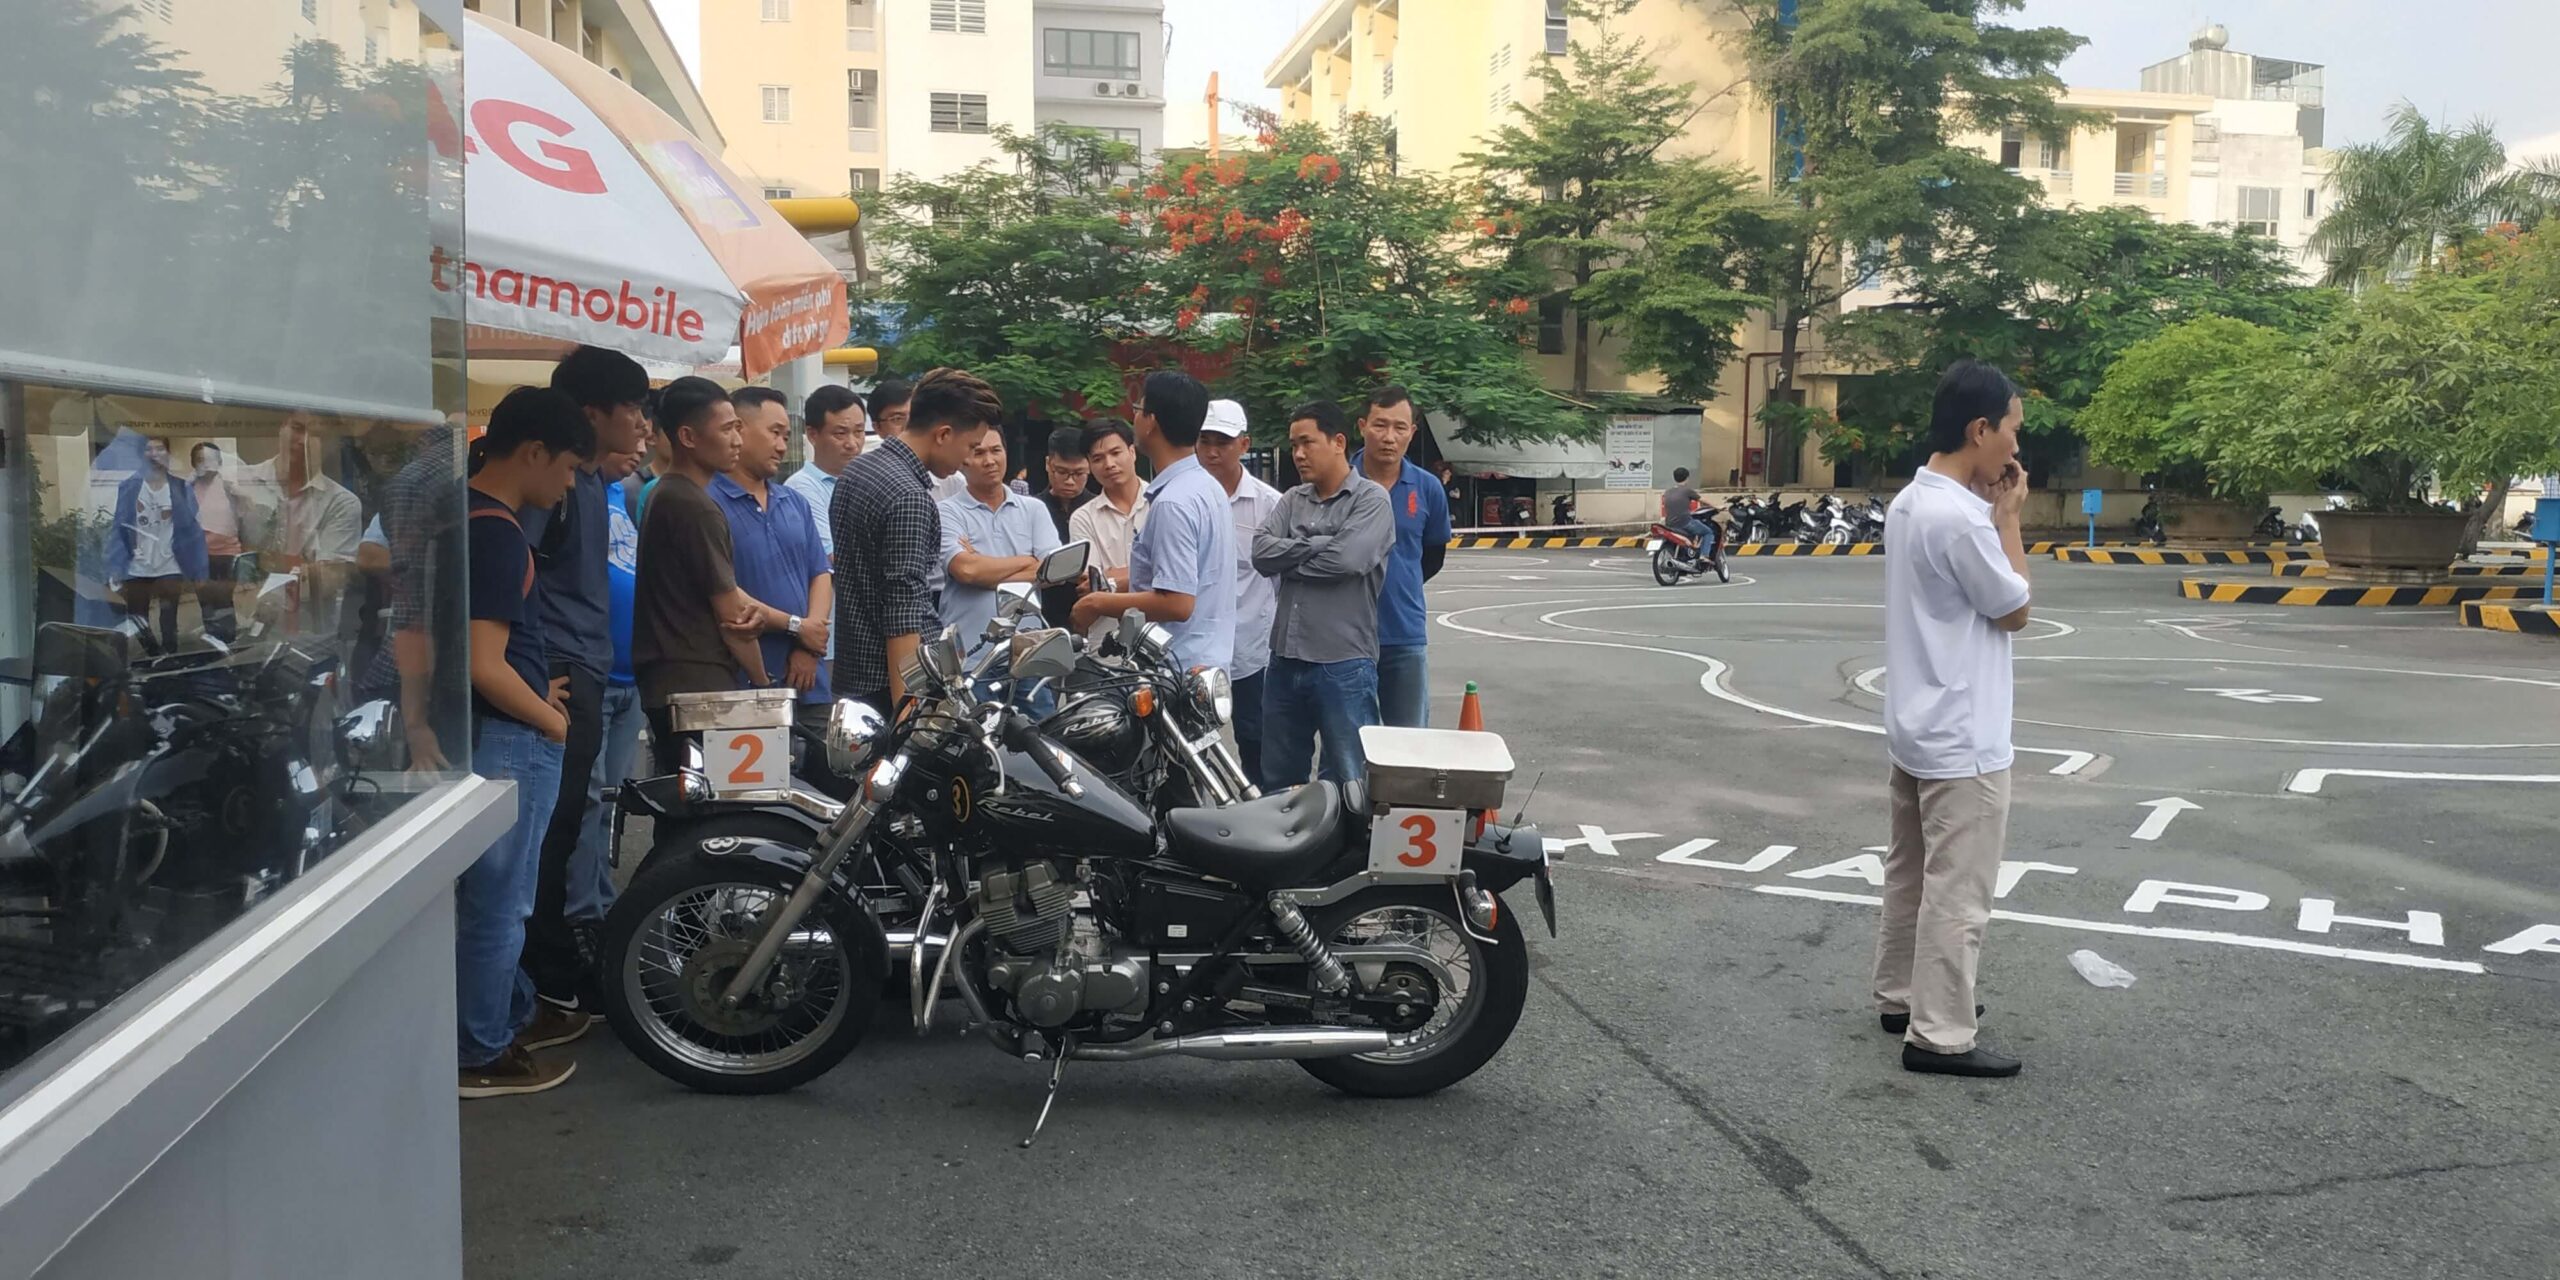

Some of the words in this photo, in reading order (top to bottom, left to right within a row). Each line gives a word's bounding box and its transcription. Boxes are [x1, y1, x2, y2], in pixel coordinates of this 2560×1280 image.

[1062, 711, 1123, 736] Rebel
[728, 733, 764, 784] 2
[976, 798, 1055, 822] Rebel
[1397, 814, 1437, 868] 3
